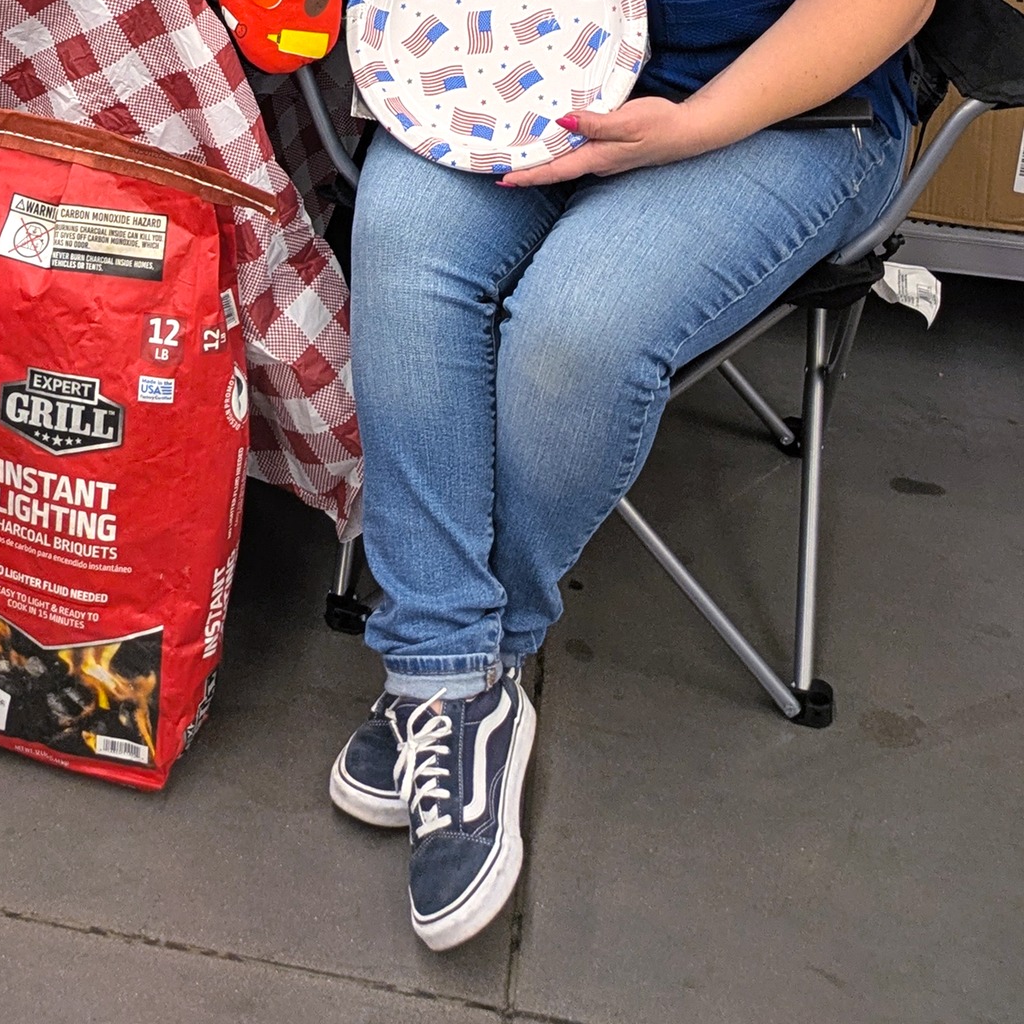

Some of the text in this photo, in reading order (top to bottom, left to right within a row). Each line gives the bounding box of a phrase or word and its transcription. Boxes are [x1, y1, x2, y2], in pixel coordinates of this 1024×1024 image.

[60, 209, 162, 228] CARBON MONOXIDE HAZARD
[60, 232, 160, 250] GIVES OFF CARBON WHICH
[80, 226, 151, 241] CHARCOAL INSIDE CAN KILL
[69, 253, 133, 267] BURN CHARCOAL INSIDE
[148, 317, 180, 347] 12
[203, 329, 220, 352] 12
[154, 348, 169, 361] LB
[32, 374, 93, 398] EXPERT
[141, 384, 161, 395] USA
[6, 392, 114, 439] GRILL
[6, 537, 14, 547] de
[37, 550, 52, 559] para
[53, 554, 88, 569] encendido
[88, 562, 132, 573] instantáneo
[53, 536, 118, 560] BRIQUETS
[5, 568, 42, 589] LIGHTER
[43, 580, 69, 597] FLUID
[70, 588, 108, 603] NEEDED
[7, 598, 85, 629] COOK IN 15 MINUTES
[16, 591, 27, 601] TO
[28, 595, 50, 610] LIGHT
[51, 604, 58, 613] &
[59, 605, 86, 620] READY
[87, 612, 99, 622] TO
[203, 566, 225, 659] INSTANT
